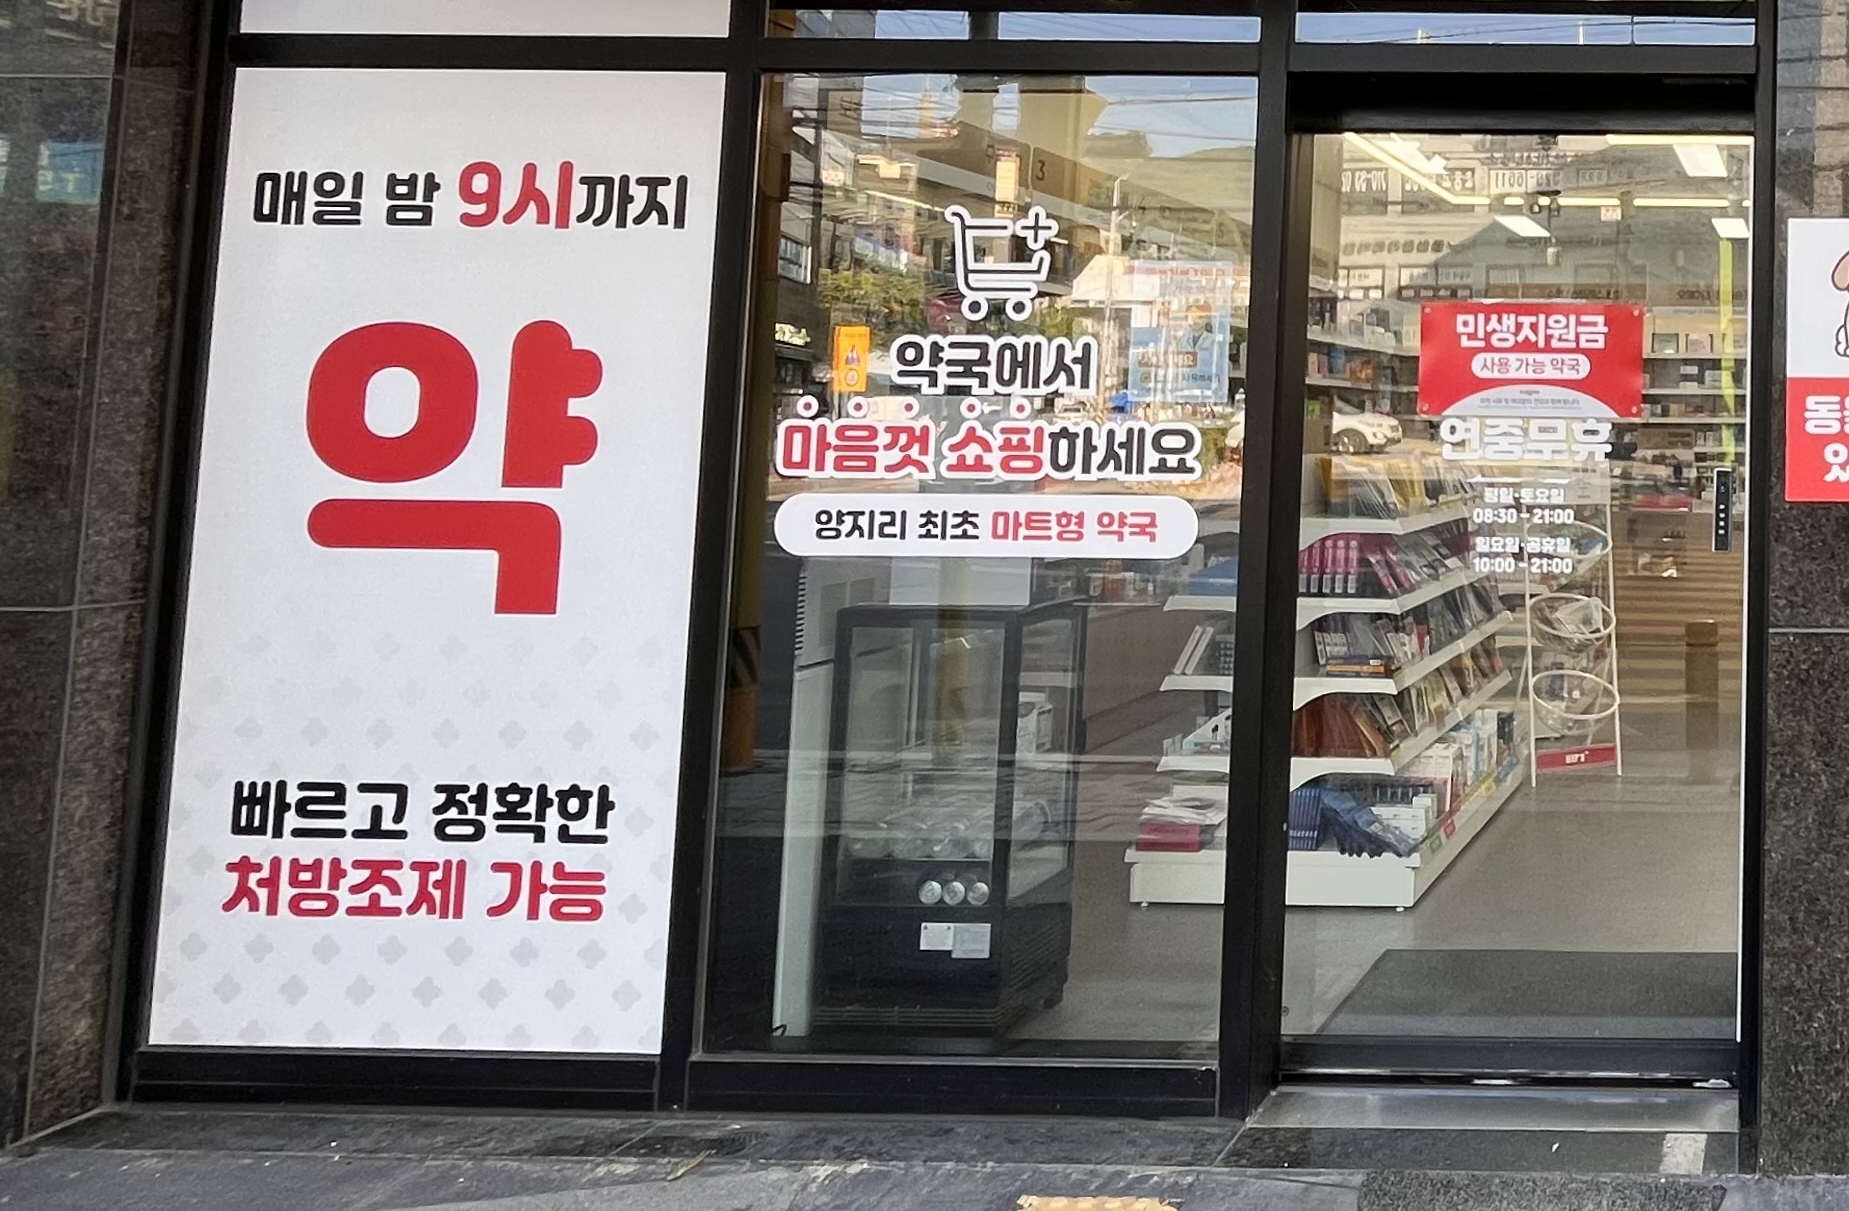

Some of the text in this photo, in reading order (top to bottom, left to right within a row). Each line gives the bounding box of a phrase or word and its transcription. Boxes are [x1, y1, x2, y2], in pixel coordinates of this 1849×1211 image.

[253, 159, 689, 230] 매일 밤 9시까지
[1455, 311, 1610, 350] 민생지원금
[893, 338, 1094, 392] 약국에서
[1479, 356, 1582, 376] 사용 가능 약국
[781, 423, 1198, 476] 마음껏 쇼핑하세요
[1439, 418, 1613, 462] 연중무휴
[306, 319, 604, 615] 약
[814, 508, 1160, 544] 양지리 최초 마트형 약국
[1472, 508, 1518, 524] 08:30
[1532, 508, 1575, 525] 21:00
[1472, 556, 1516, 573] 10:00
[1530, 557, 1574, 574] 21:00
[230, 778, 617, 845] 빠르고 정확한
[220, 853, 607, 924] 처방조제 가능
